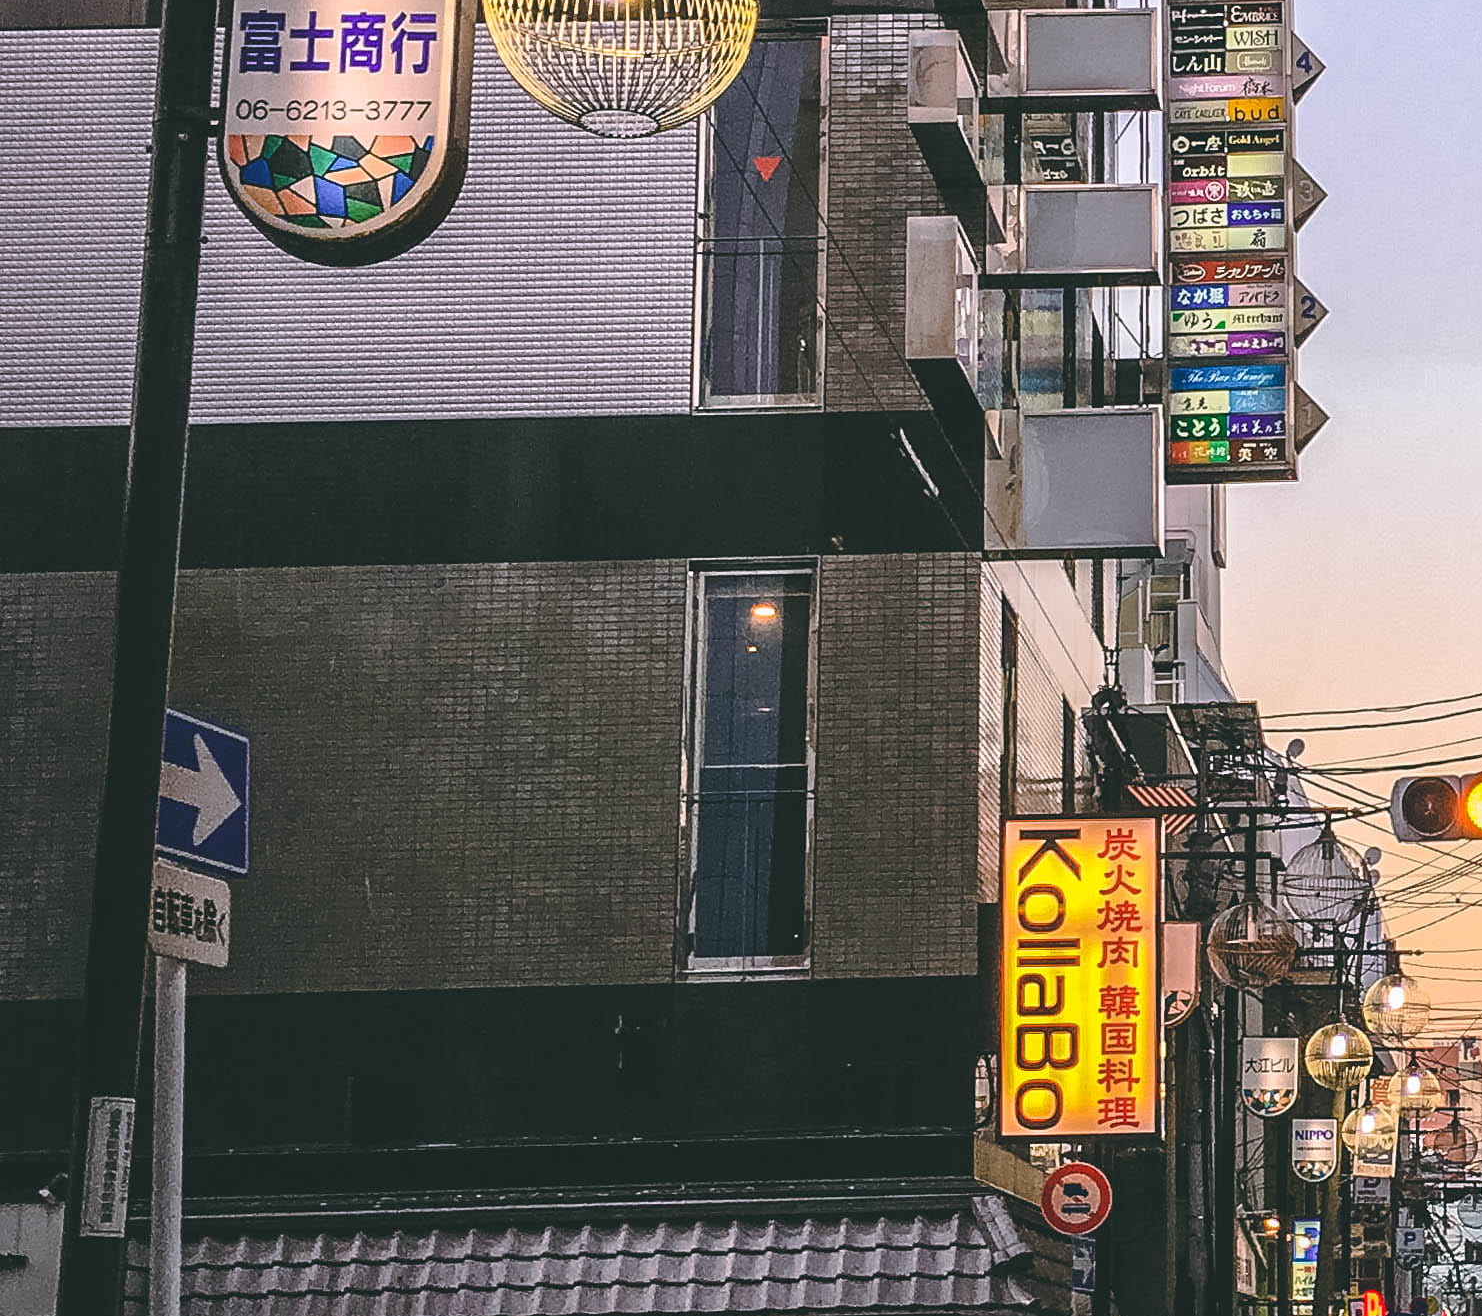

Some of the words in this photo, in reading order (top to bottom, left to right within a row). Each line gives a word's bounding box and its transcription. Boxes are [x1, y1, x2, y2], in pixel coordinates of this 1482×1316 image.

[239, 10, 438, 75] 富士商行
[1233, 29, 1279, 46] WISH
[1172, 54, 1222, 72] しん山
[1296, 50, 1313, 75] 4
[235, 99, 433, 121] 06-6213-3777
[1228, 134, 1250, 144] Gold
[1252, 133, 1280, 145] Angel
[1173, 207, 1225, 227] つばさ
[1231, 208, 1282, 221] おもちゃ箱
[1301, 296, 1317, 320] 2
[1184, 312, 1213, 330] ゆう
[1176, 418, 1221, 437] ことう
[1097, 828, 1142, 969] 炭火焼肉
[1097, 984, 1141, 1129] 韓国料理
[1245, 1058, 1294, 1074] 大江ビル
[1295, 1130, 1333, 1141] NIPPO
